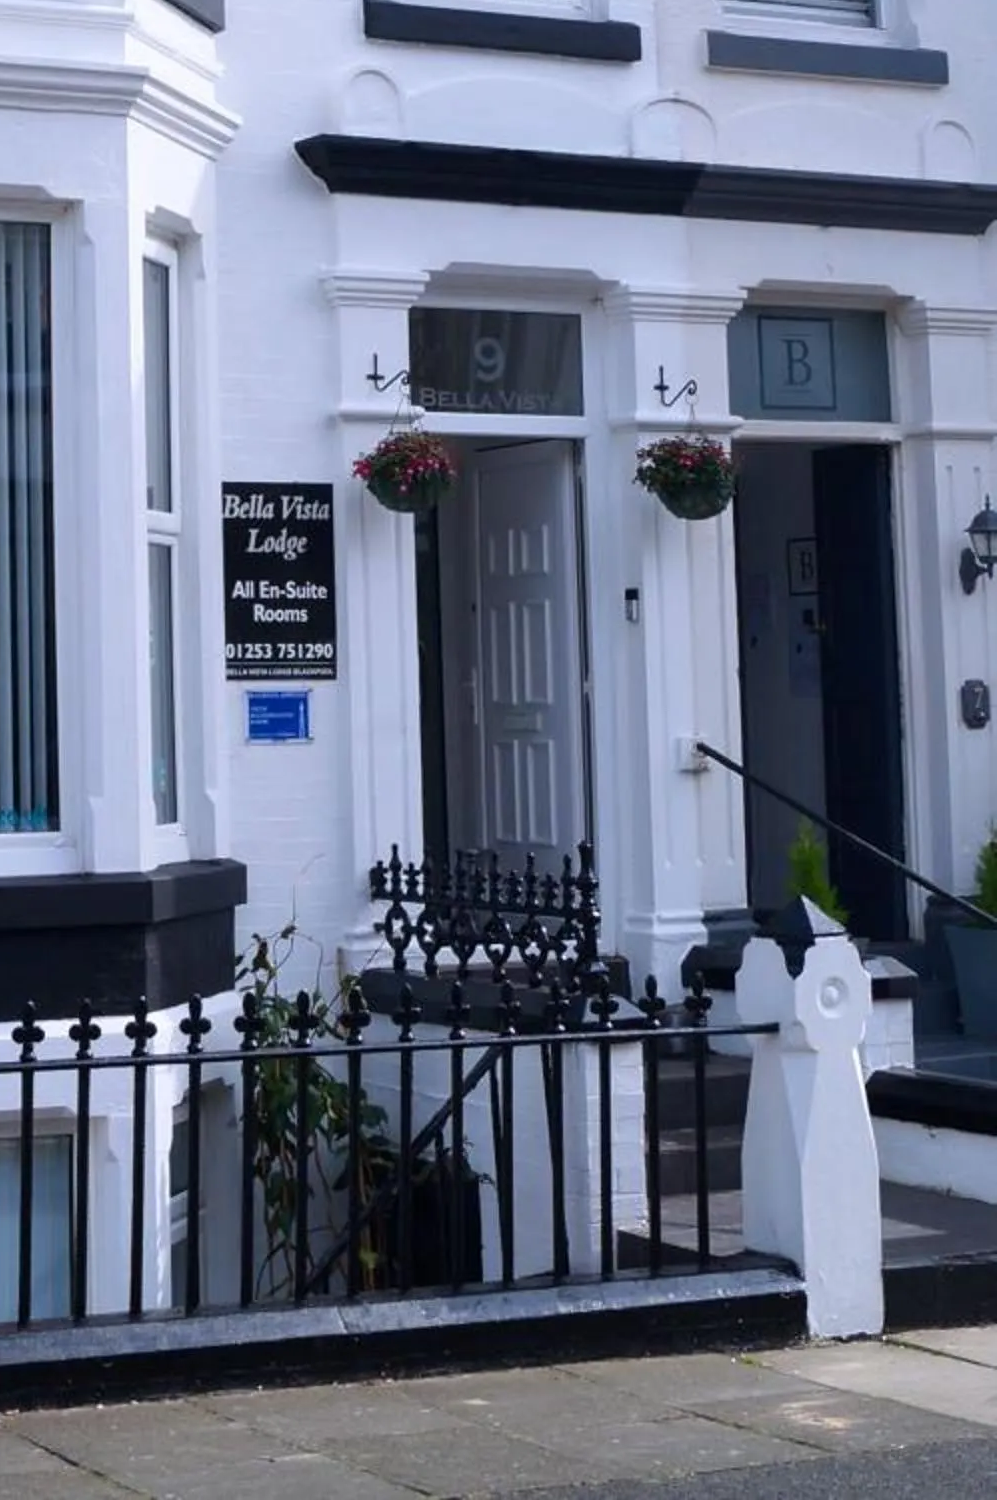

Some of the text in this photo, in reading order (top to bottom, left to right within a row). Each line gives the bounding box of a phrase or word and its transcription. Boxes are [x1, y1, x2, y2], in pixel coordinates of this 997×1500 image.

[474, 337, 505, 382] 9
[781, 338, 812, 386] B
[419, 387, 494, 408] BELLA
[223, 494, 330, 520] Bella Vista
[246, 527, 308, 561] Lodge
[800, 550, 814, 581] B
[232, 580, 328, 599] All En-Suite
[254, 603, 308, 622] Rooms
[226, 643, 334, 659] 01253 751290
[973, 687, 984, 709] 7
